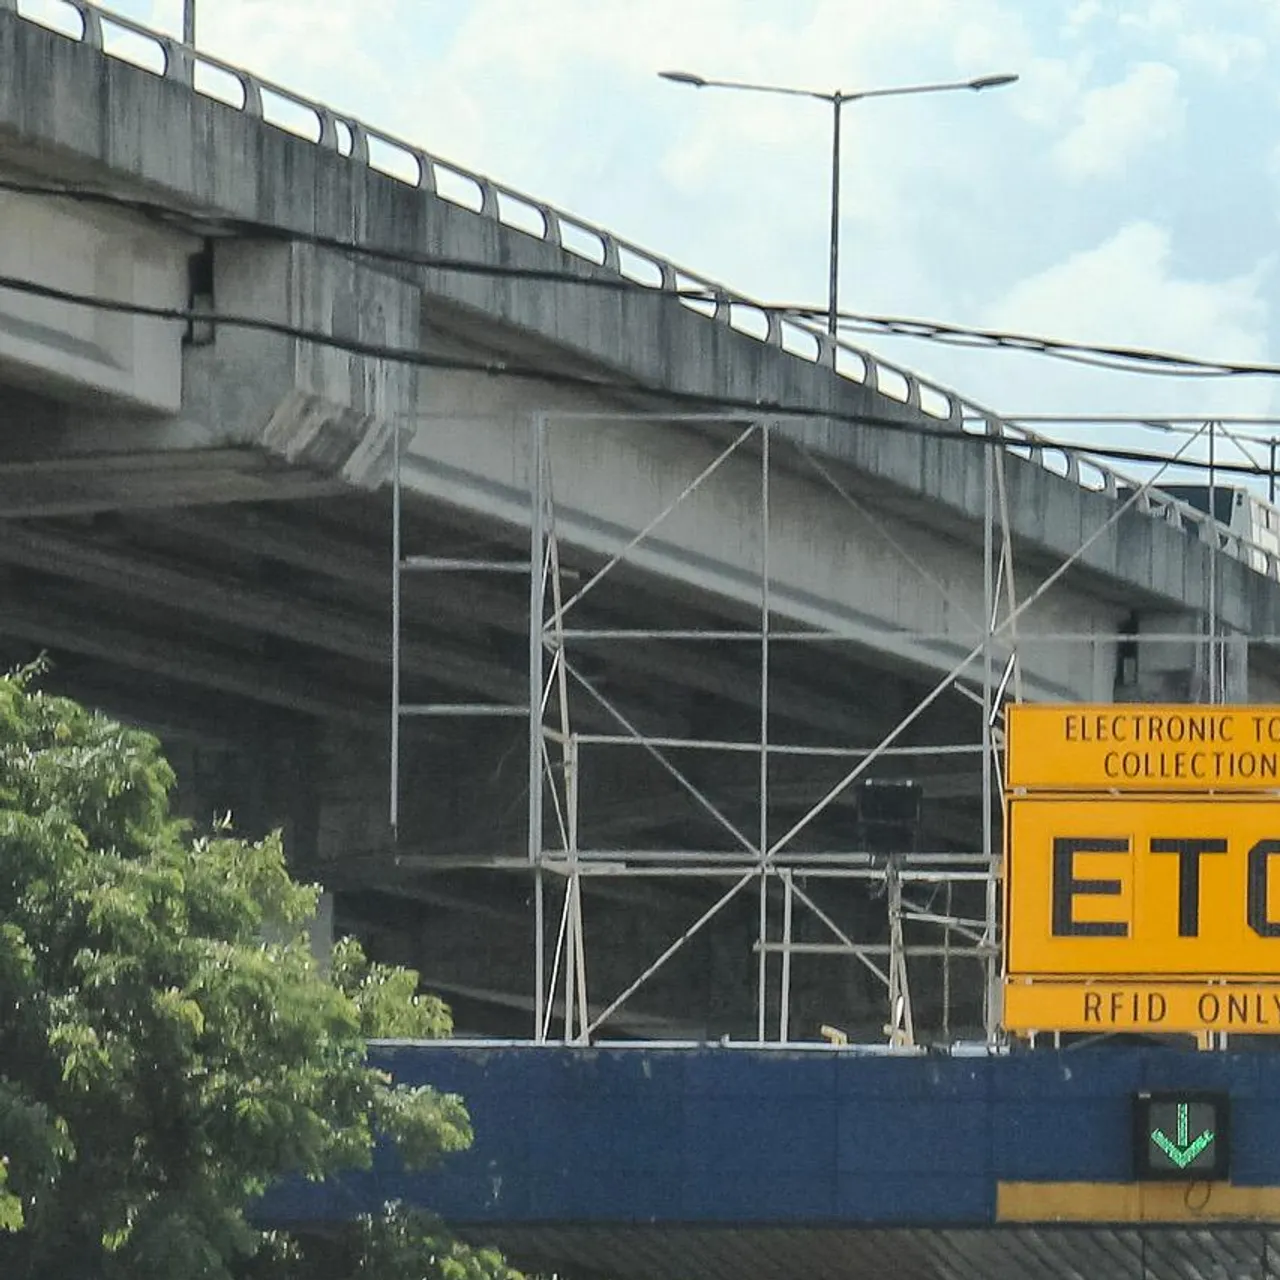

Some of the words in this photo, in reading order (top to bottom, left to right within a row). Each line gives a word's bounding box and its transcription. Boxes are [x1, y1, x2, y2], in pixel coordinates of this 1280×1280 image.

[1065, 715, 1234, 743] ELECTRONIC
[1104, 752, 1278, 779] COLLECTION
[1084, 992, 1167, 1024] RFID
